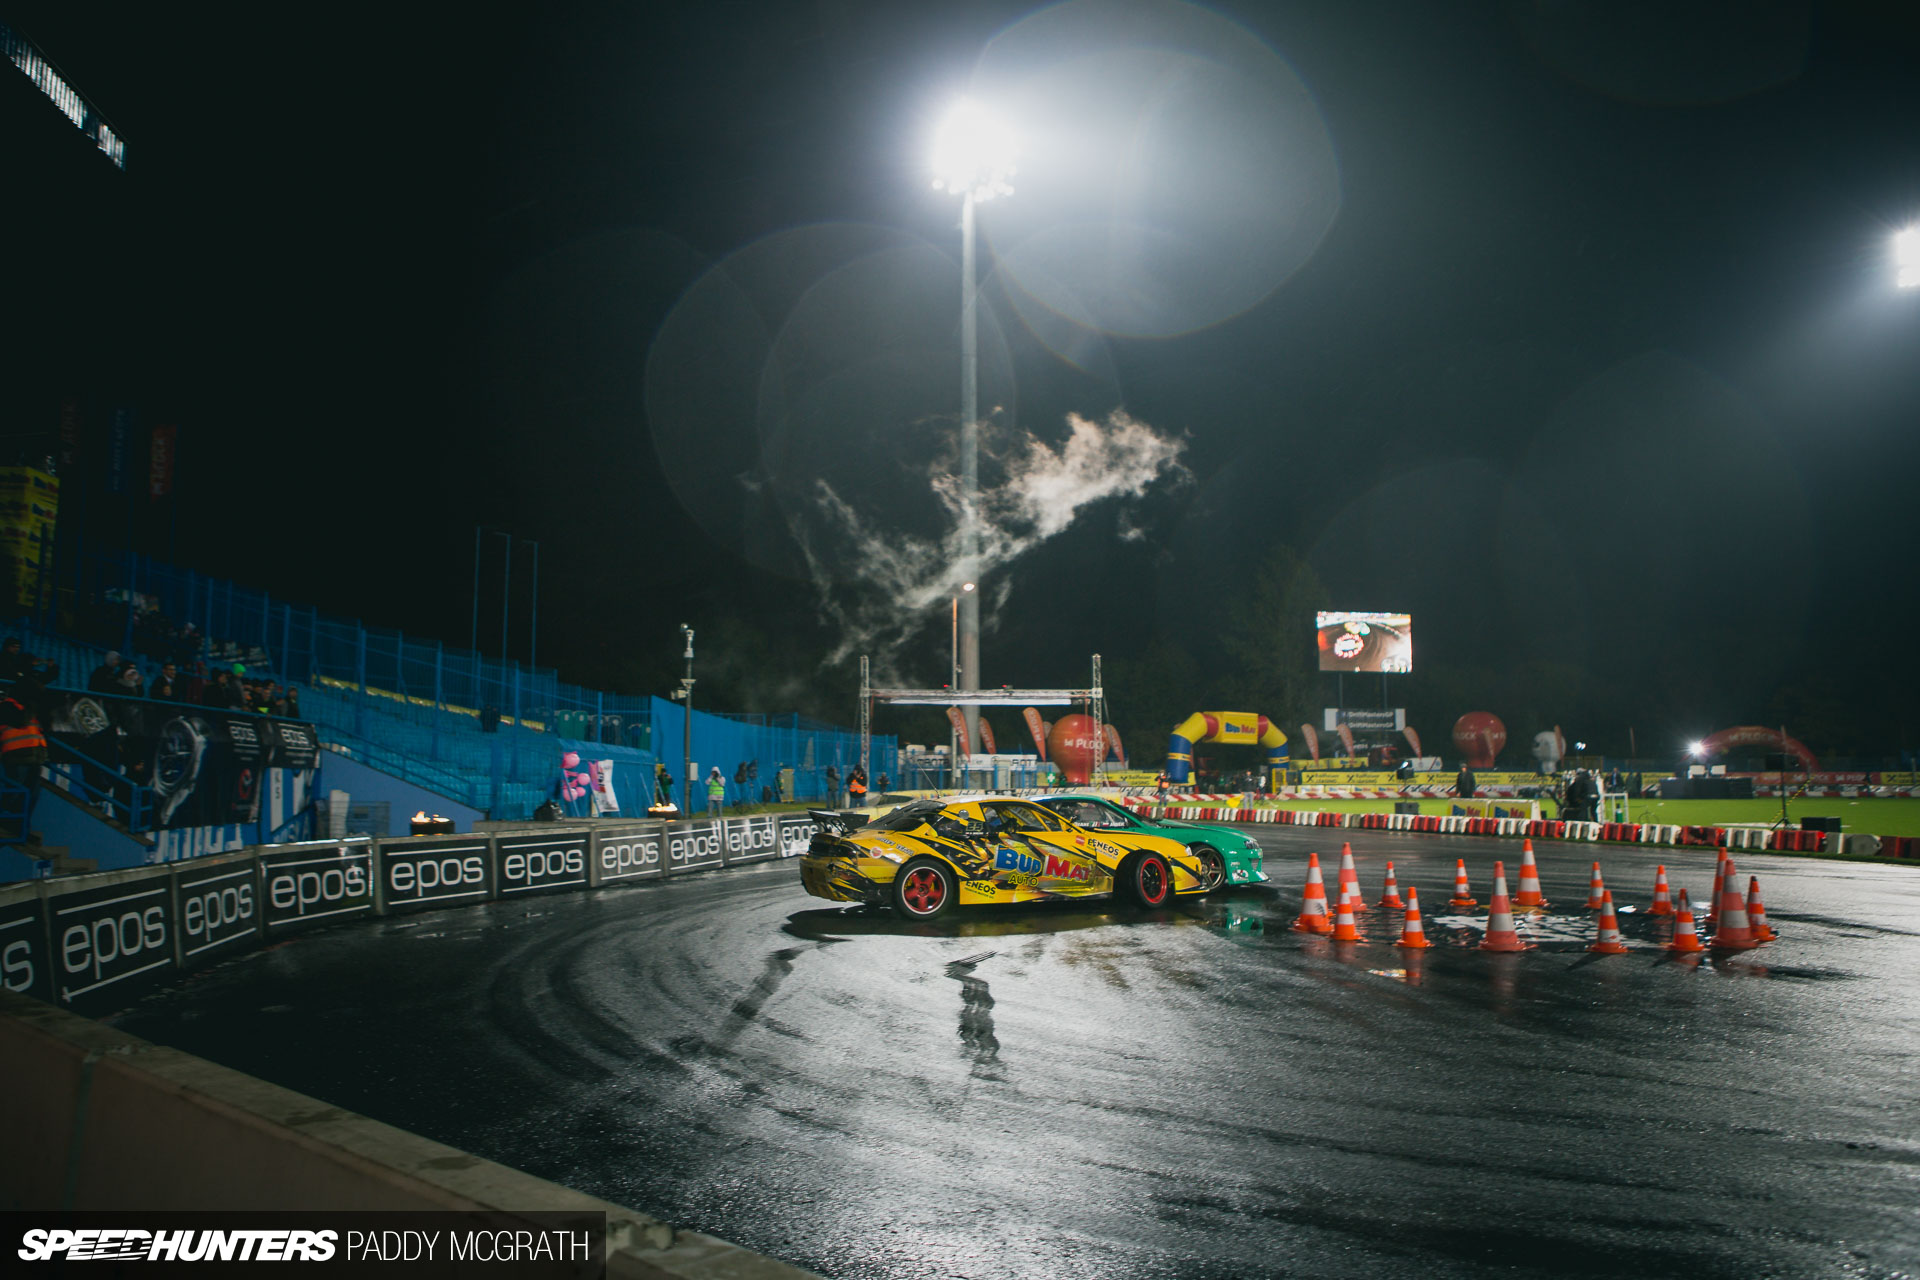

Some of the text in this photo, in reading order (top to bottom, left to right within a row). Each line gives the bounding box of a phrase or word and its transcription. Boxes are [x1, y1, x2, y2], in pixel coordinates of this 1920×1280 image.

[670, 834, 720, 864] epos
[728, 828, 772, 857] epos
[781, 822, 818, 852] epos
[504, 848, 584, 885] epos
[601, 841, 659, 873] epos
[270, 866, 366, 914] epos
[390, 856, 484, 898] epos
[966, 881, 996, 895] ENEOS
[1008, 874, 1039, 887] AUTO
[185, 883, 253, 941] epos
[62, 906, 166, 979] epos
